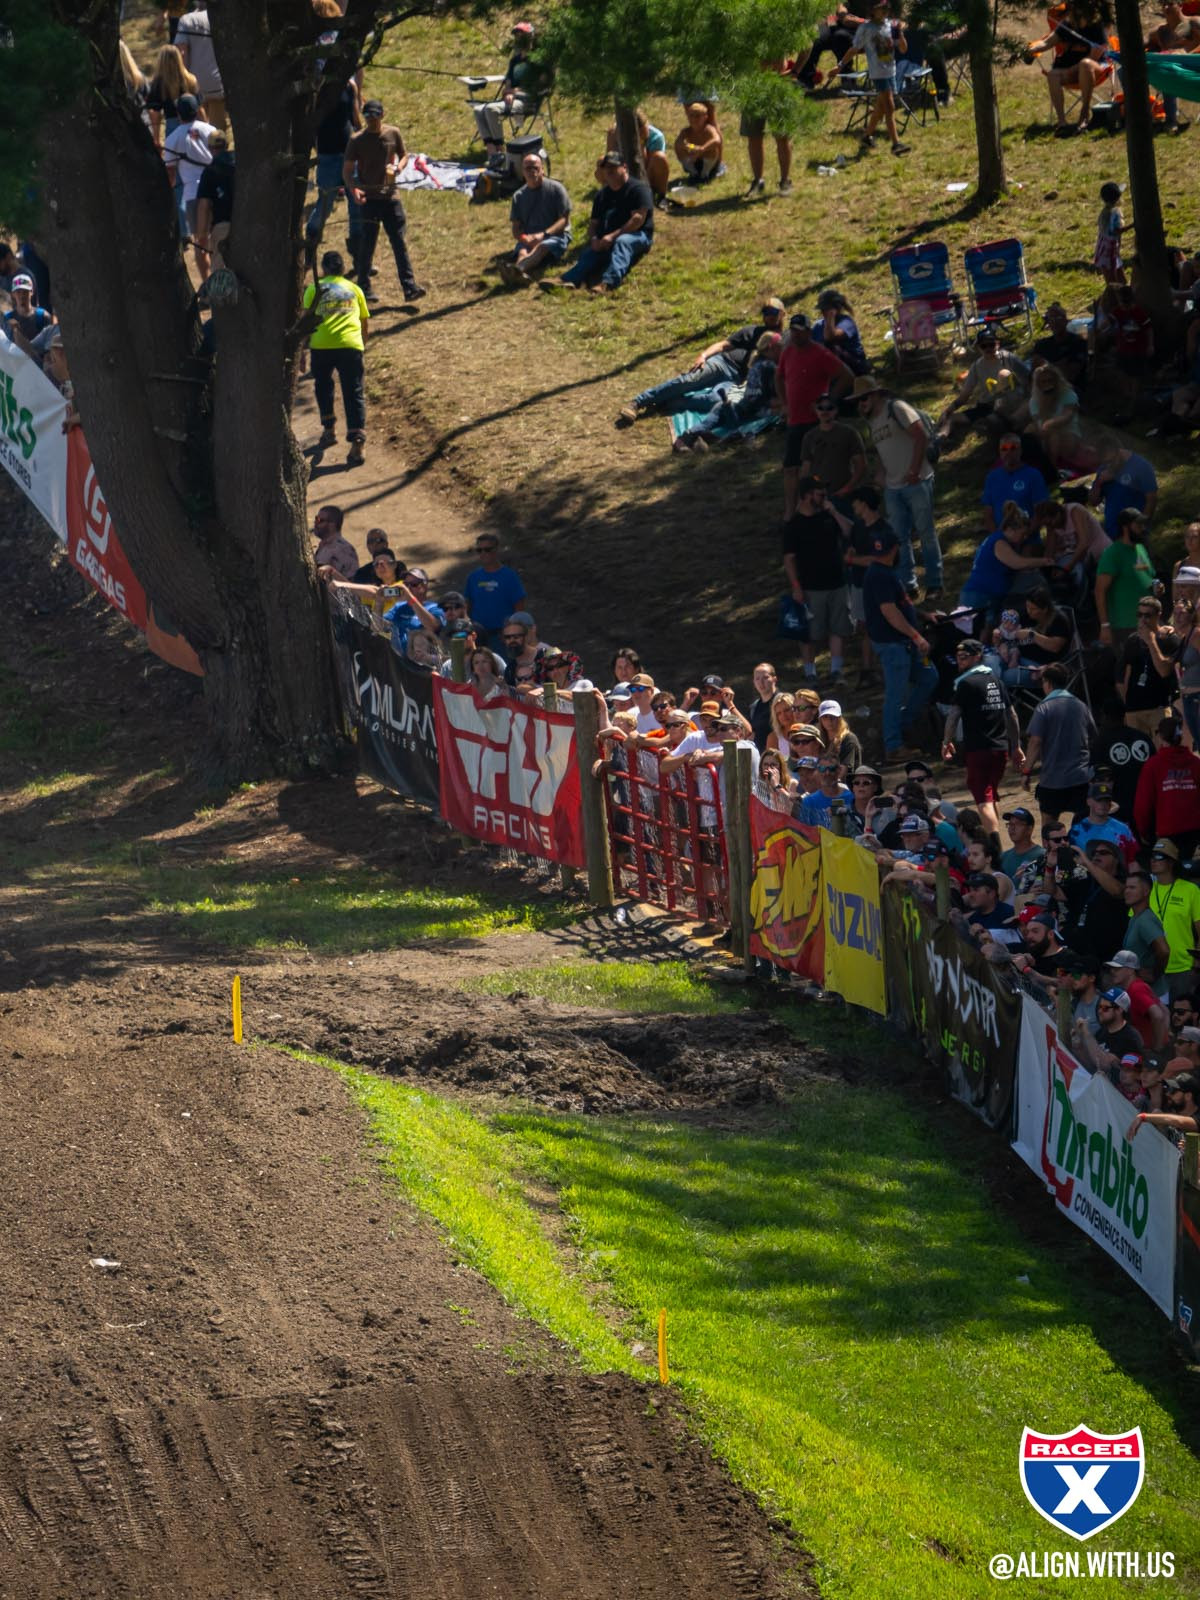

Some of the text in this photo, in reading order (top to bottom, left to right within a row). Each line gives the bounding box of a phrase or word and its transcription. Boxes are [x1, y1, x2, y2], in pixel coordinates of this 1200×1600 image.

[442, 688, 576, 817] FLY
[473, 806, 552, 850] RACING
[750, 845, 821, 930] FMF
[1120, 1236, 1143, 1275] STORES
